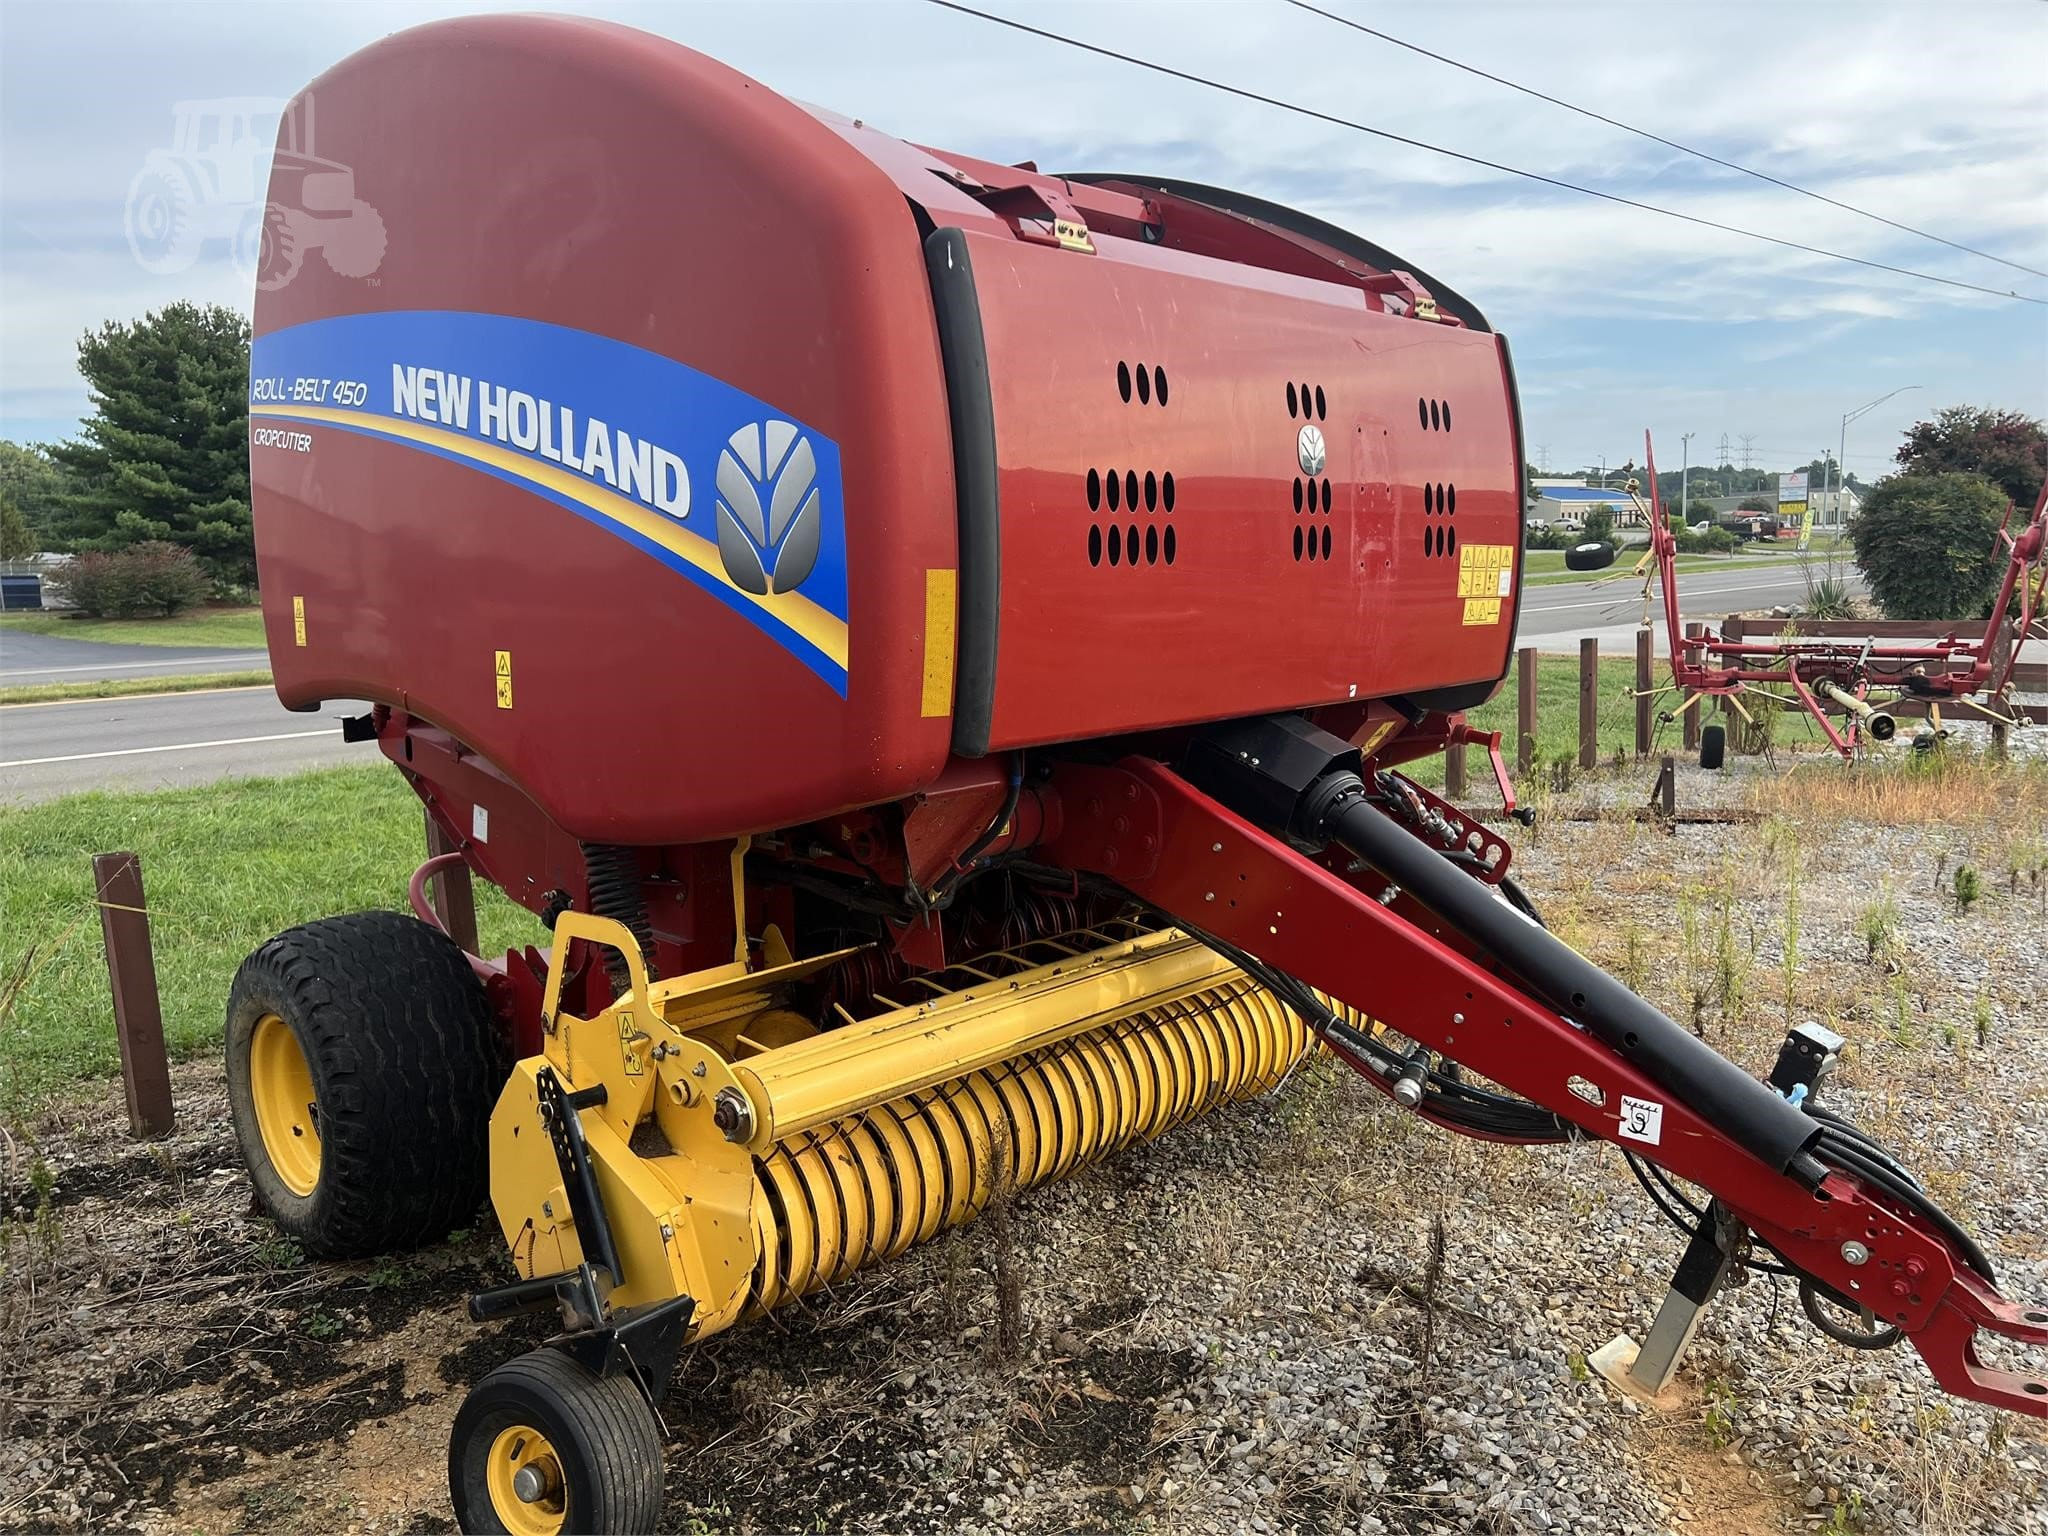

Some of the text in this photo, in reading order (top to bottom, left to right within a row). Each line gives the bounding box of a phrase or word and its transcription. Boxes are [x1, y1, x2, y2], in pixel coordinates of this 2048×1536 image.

[252, 378, 368, 407] ROLL-BELT 450
[253, 428, 312, 452] CROPCUTTER
[392, 363, 691, 519] NEW HOLLAND
